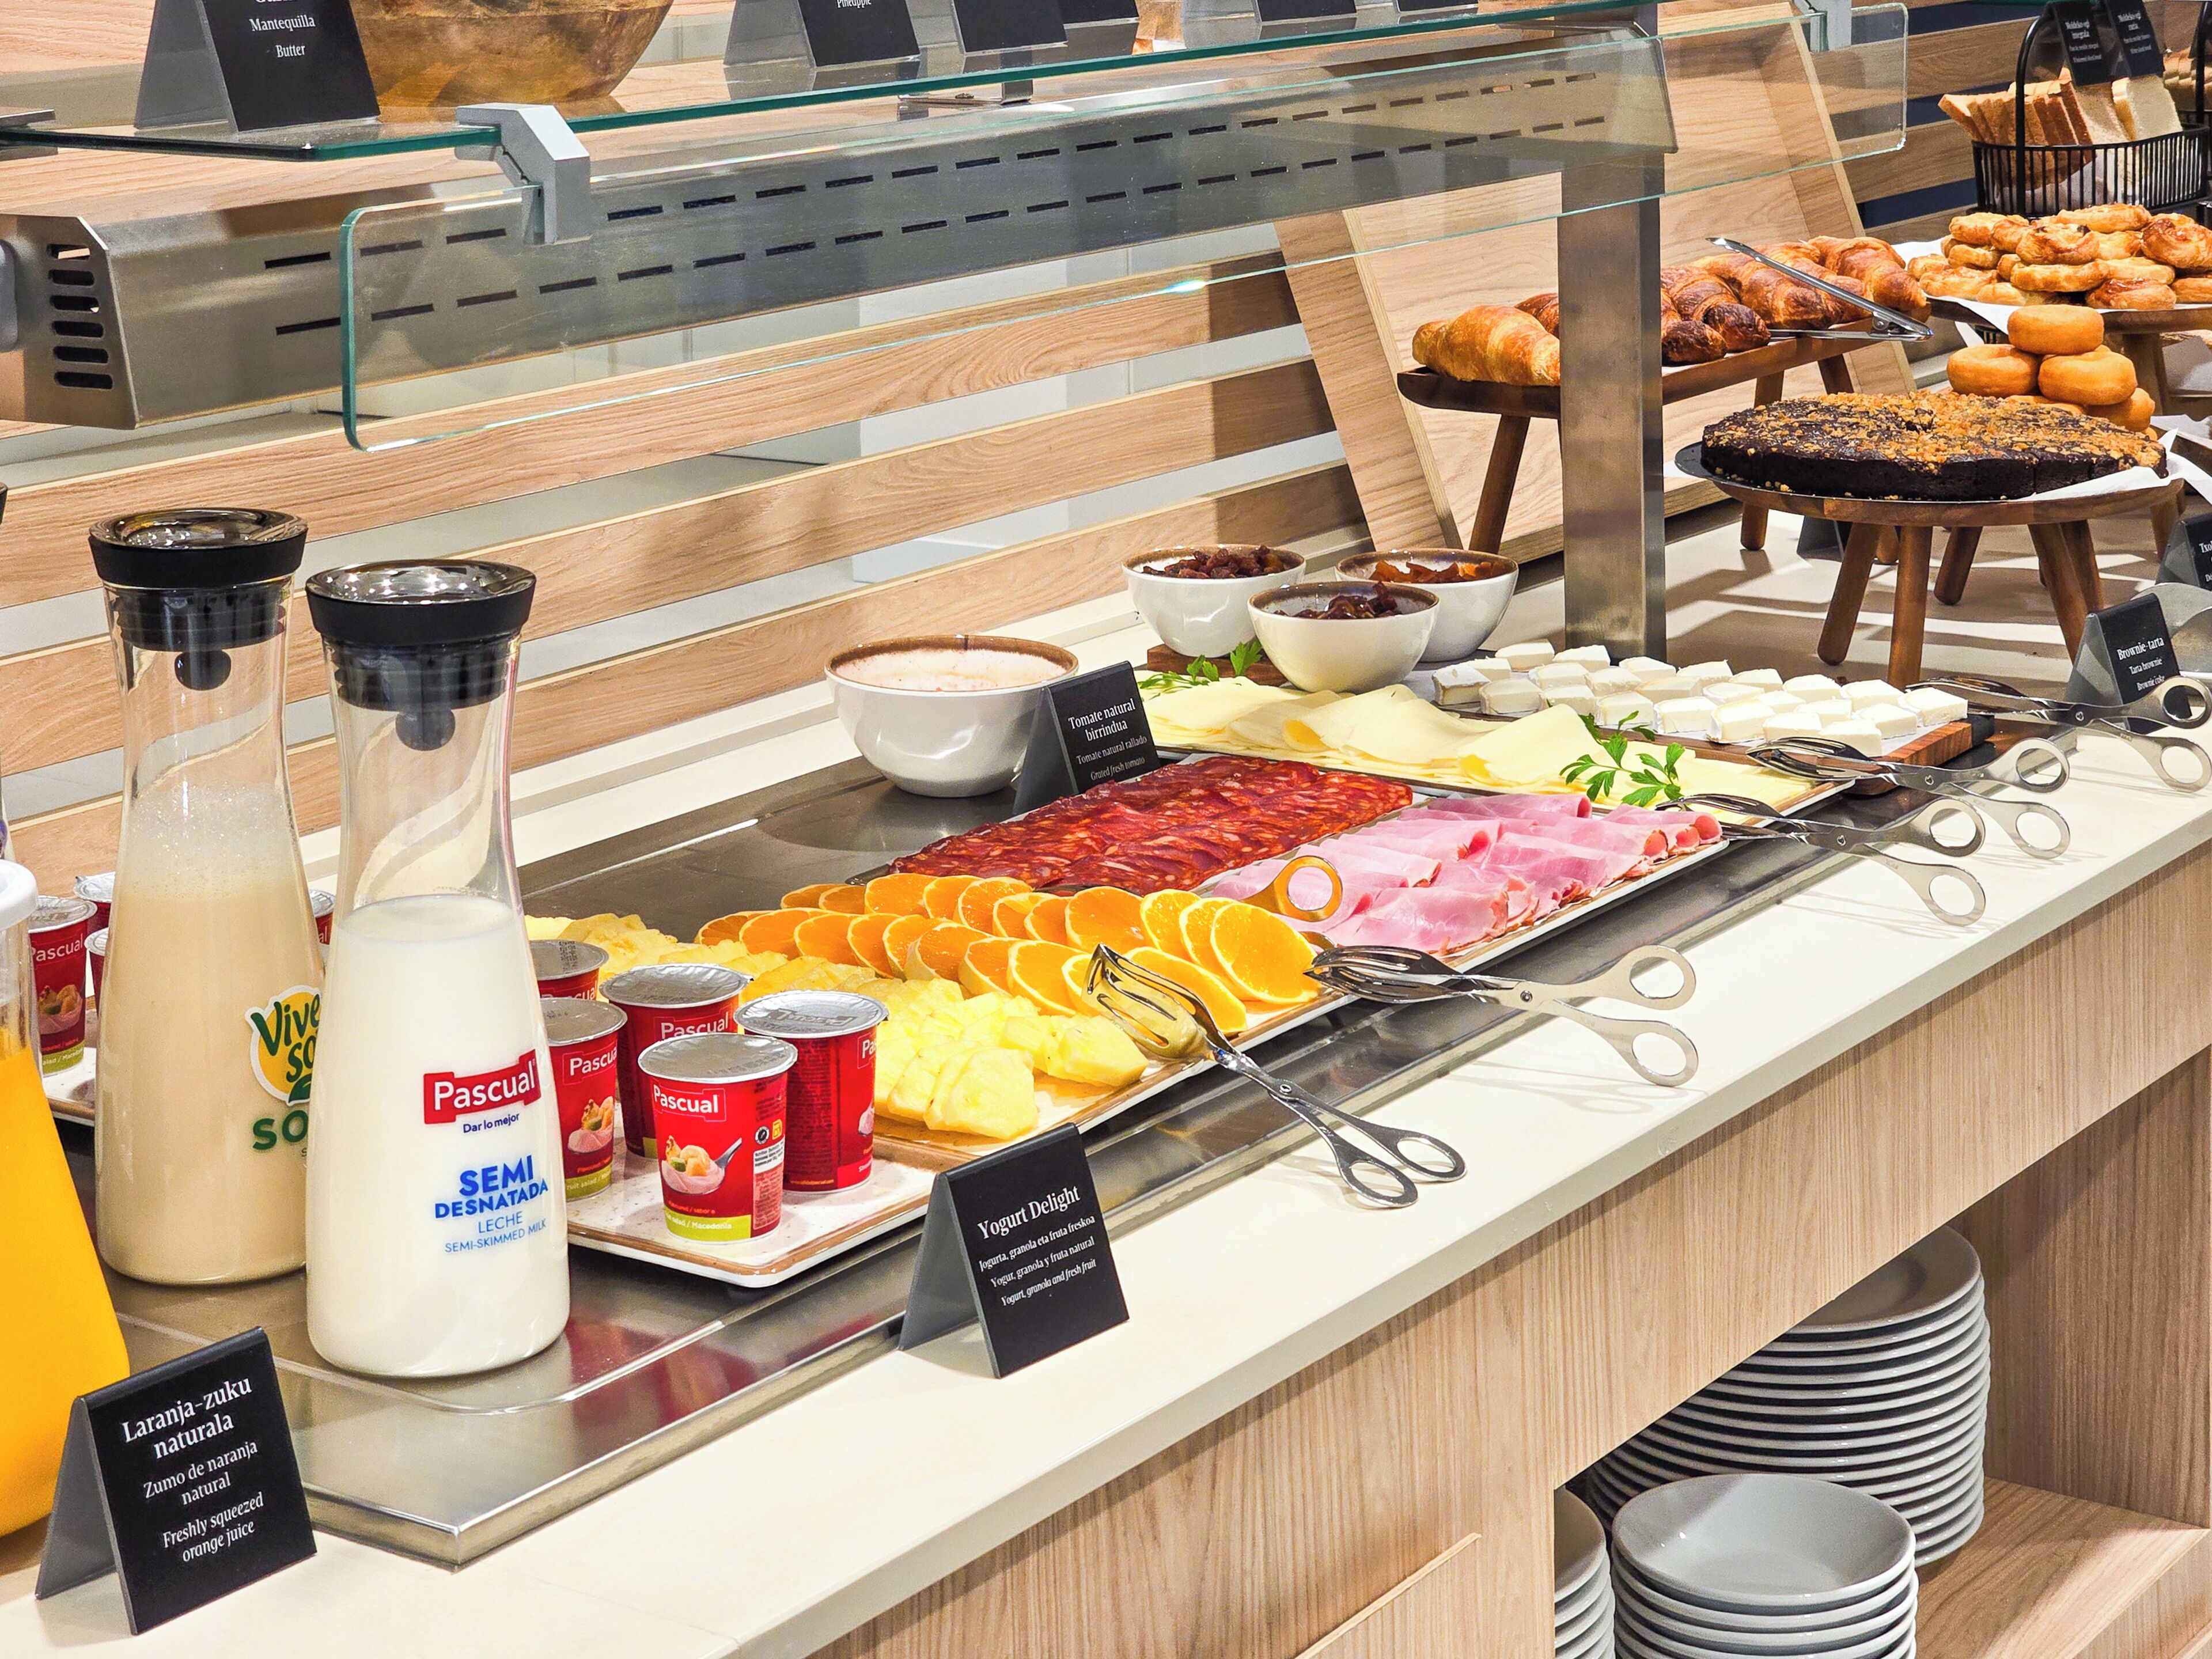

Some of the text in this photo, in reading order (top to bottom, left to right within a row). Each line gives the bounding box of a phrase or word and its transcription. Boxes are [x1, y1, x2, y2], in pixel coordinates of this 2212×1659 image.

[249, 14, 316, 31] Mantequilla
[275, 44, 305, 58] Butter
[2116, 637, 2165, 660] Brownie-tarta
[2129, 657, 2162, 675] Tarta brownie
[1068, 698, 1135, 729] Tomate natural
[1085, 720, 1128, 741] birrindua
[1076, 735, 1147, 764] Tomate natural rallado
[1090, 756, 1145, 781] Grated fresh tomato
[661, 1012, 729, 1039] Pascual
[570, 1047, 618, 1076] Pascua
[434, 1061, 535, 1111] Pascual
[653, 1084, 719, 1113] Pascual
[463, 1113, 520, 1133] Dar lo mejor
[459, 1154, 534, 1196] SEMI
[435, 1178, 548, 1219] DESNATADA
[977, 1185, 1081, 1240] Yogurt Delight
[445, 1218, 546, 1253] SEMI-SKIMMED MILK
[478, 1211, 523, 1234] LECHE
[691, 1221, 732, 1229] Macedonia
[979, 1215, 1095, 1272] Jogurta, granola eta fruta freskoa
[990, 1236, 1094, 1288] Yogur, granola y fruta natural
[1001, 1258, 1096, 1306] Yogurt, granola and fresh fruit
[122, 1377, 252, 1443] Laranja-zuku
[153, 1413, 234, 1459] naturala
[143, 1440, 258, 1499] Zumo de naranja
[181, 1472, 231, 1505] natural
[163, 1491, 264, 1548] Freshly squeezed
[182, 1520, 255, 1563] orange juice
